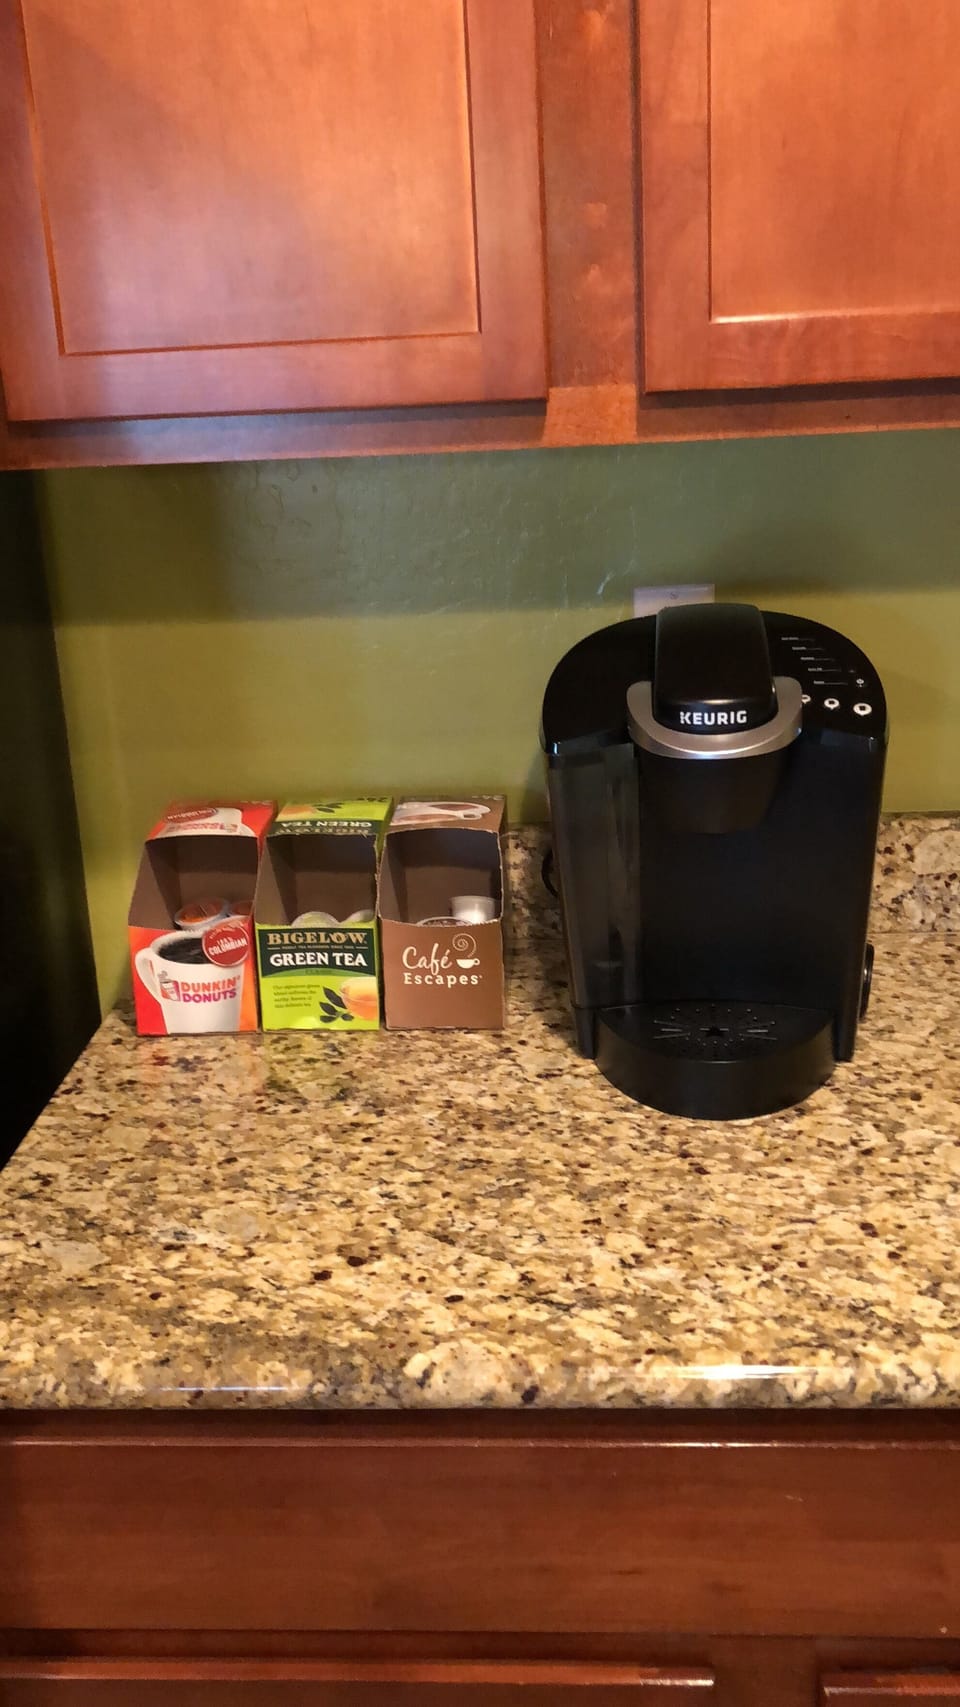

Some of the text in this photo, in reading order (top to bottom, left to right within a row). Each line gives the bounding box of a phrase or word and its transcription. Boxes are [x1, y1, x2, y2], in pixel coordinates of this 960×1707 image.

[679, 709, 748, 725] KEURIG
[280, 820, 372, 828] GREEN TEA
[267, 932, 367, 945] BIGELOW
[208, 937, 248, 956] COLOMBIAN
[269, 952, 368, 967] GREEN TEA
[402, 943, 452, 979] Café
[403, 971, 479, 988] Escapes
[182, 988, 237, 1003] DONUTS
